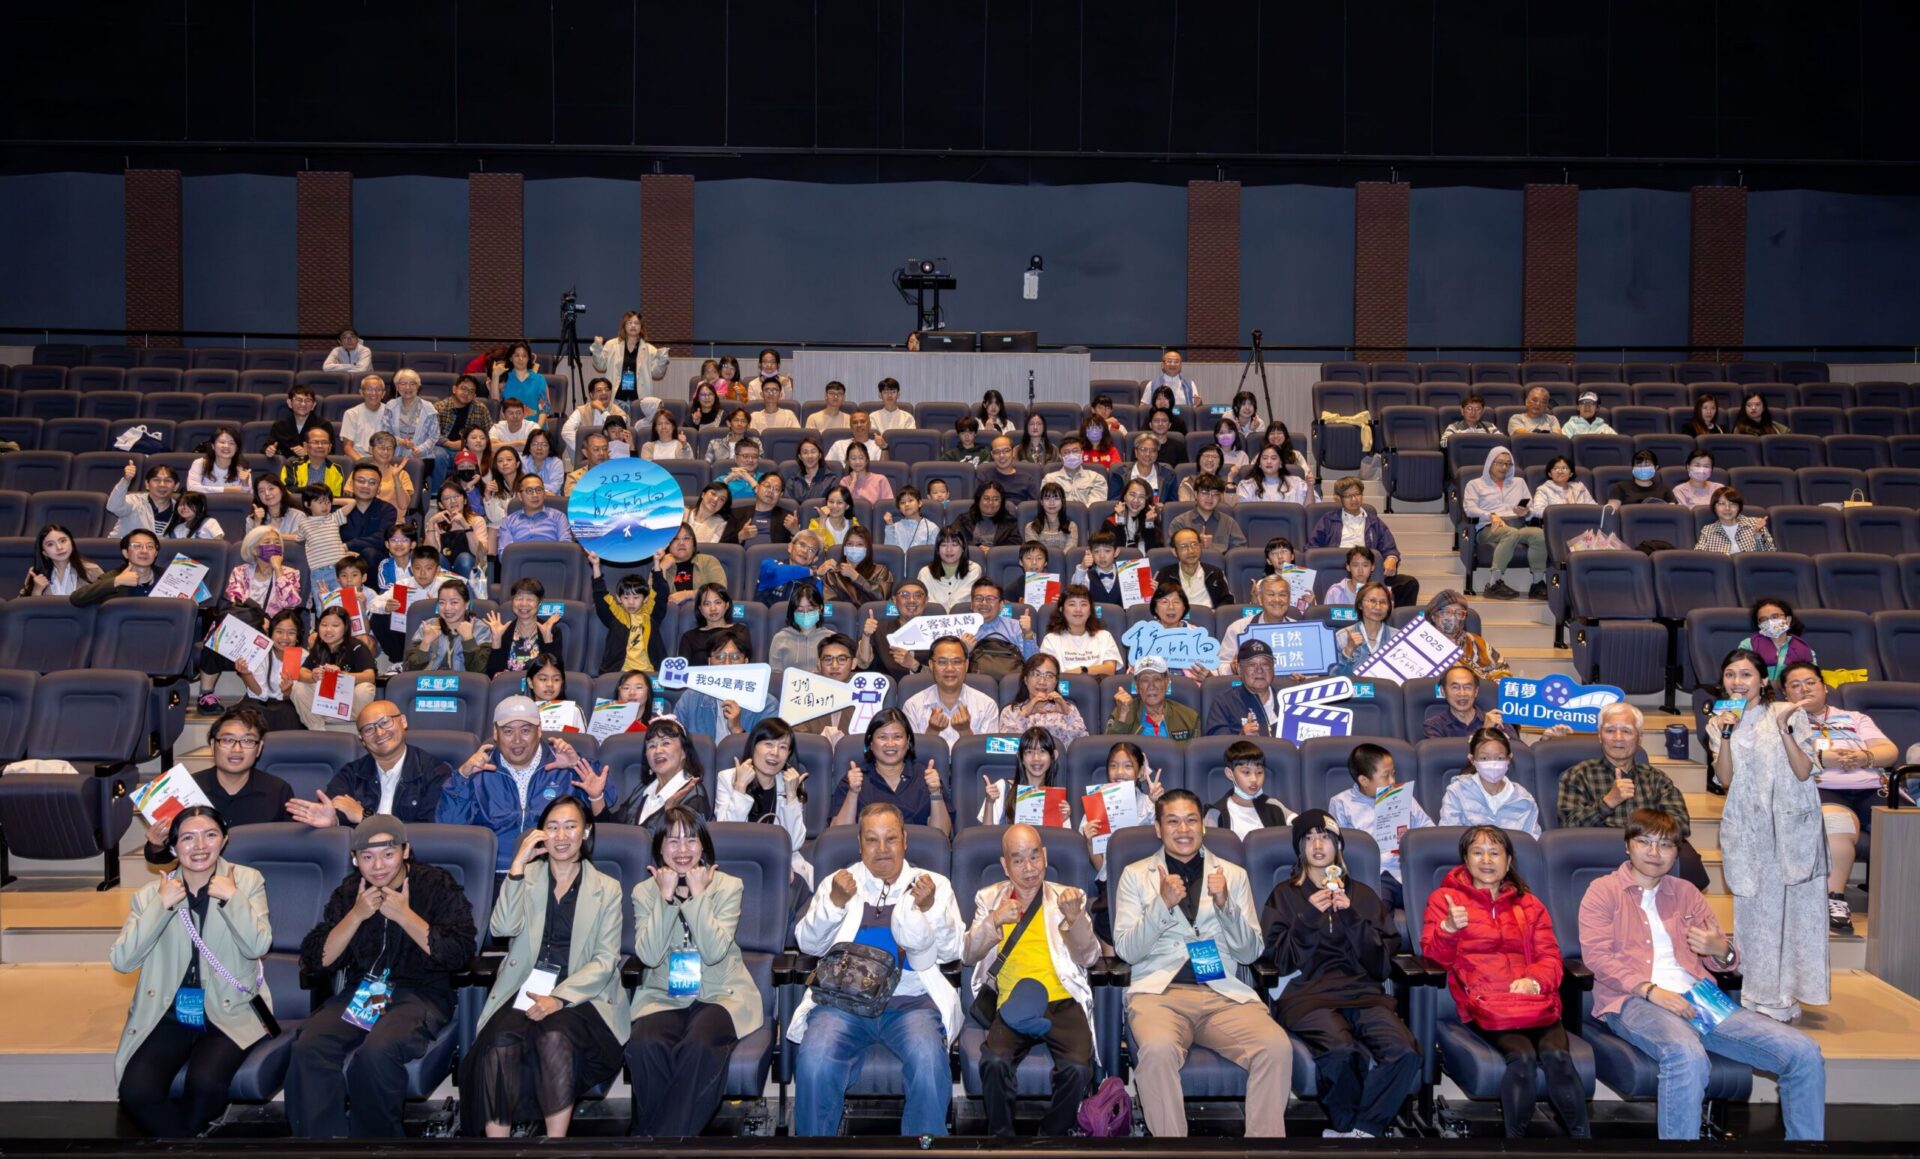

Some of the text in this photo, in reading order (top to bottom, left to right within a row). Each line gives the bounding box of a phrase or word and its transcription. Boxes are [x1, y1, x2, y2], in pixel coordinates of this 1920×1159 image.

[600, 472, 642, 484] 2025
[926, 615, 975, 630] 客家人的
[1271, 631, 1302, 647] 自然
[1419, 630, 1444, 652] 2025
[1274, 651, 1304, 667] 而然
[695, 673, 757, 693] 我94是青客
[1504, 681, 1537, 699] 舊夢
[1502, 701, 1597, 724] Old Dreams
[1196, 963, 1221, 975] STAFF
[672, 980, 697, 989] STAFF
[180, 1015, 201, 1025] STAFF
